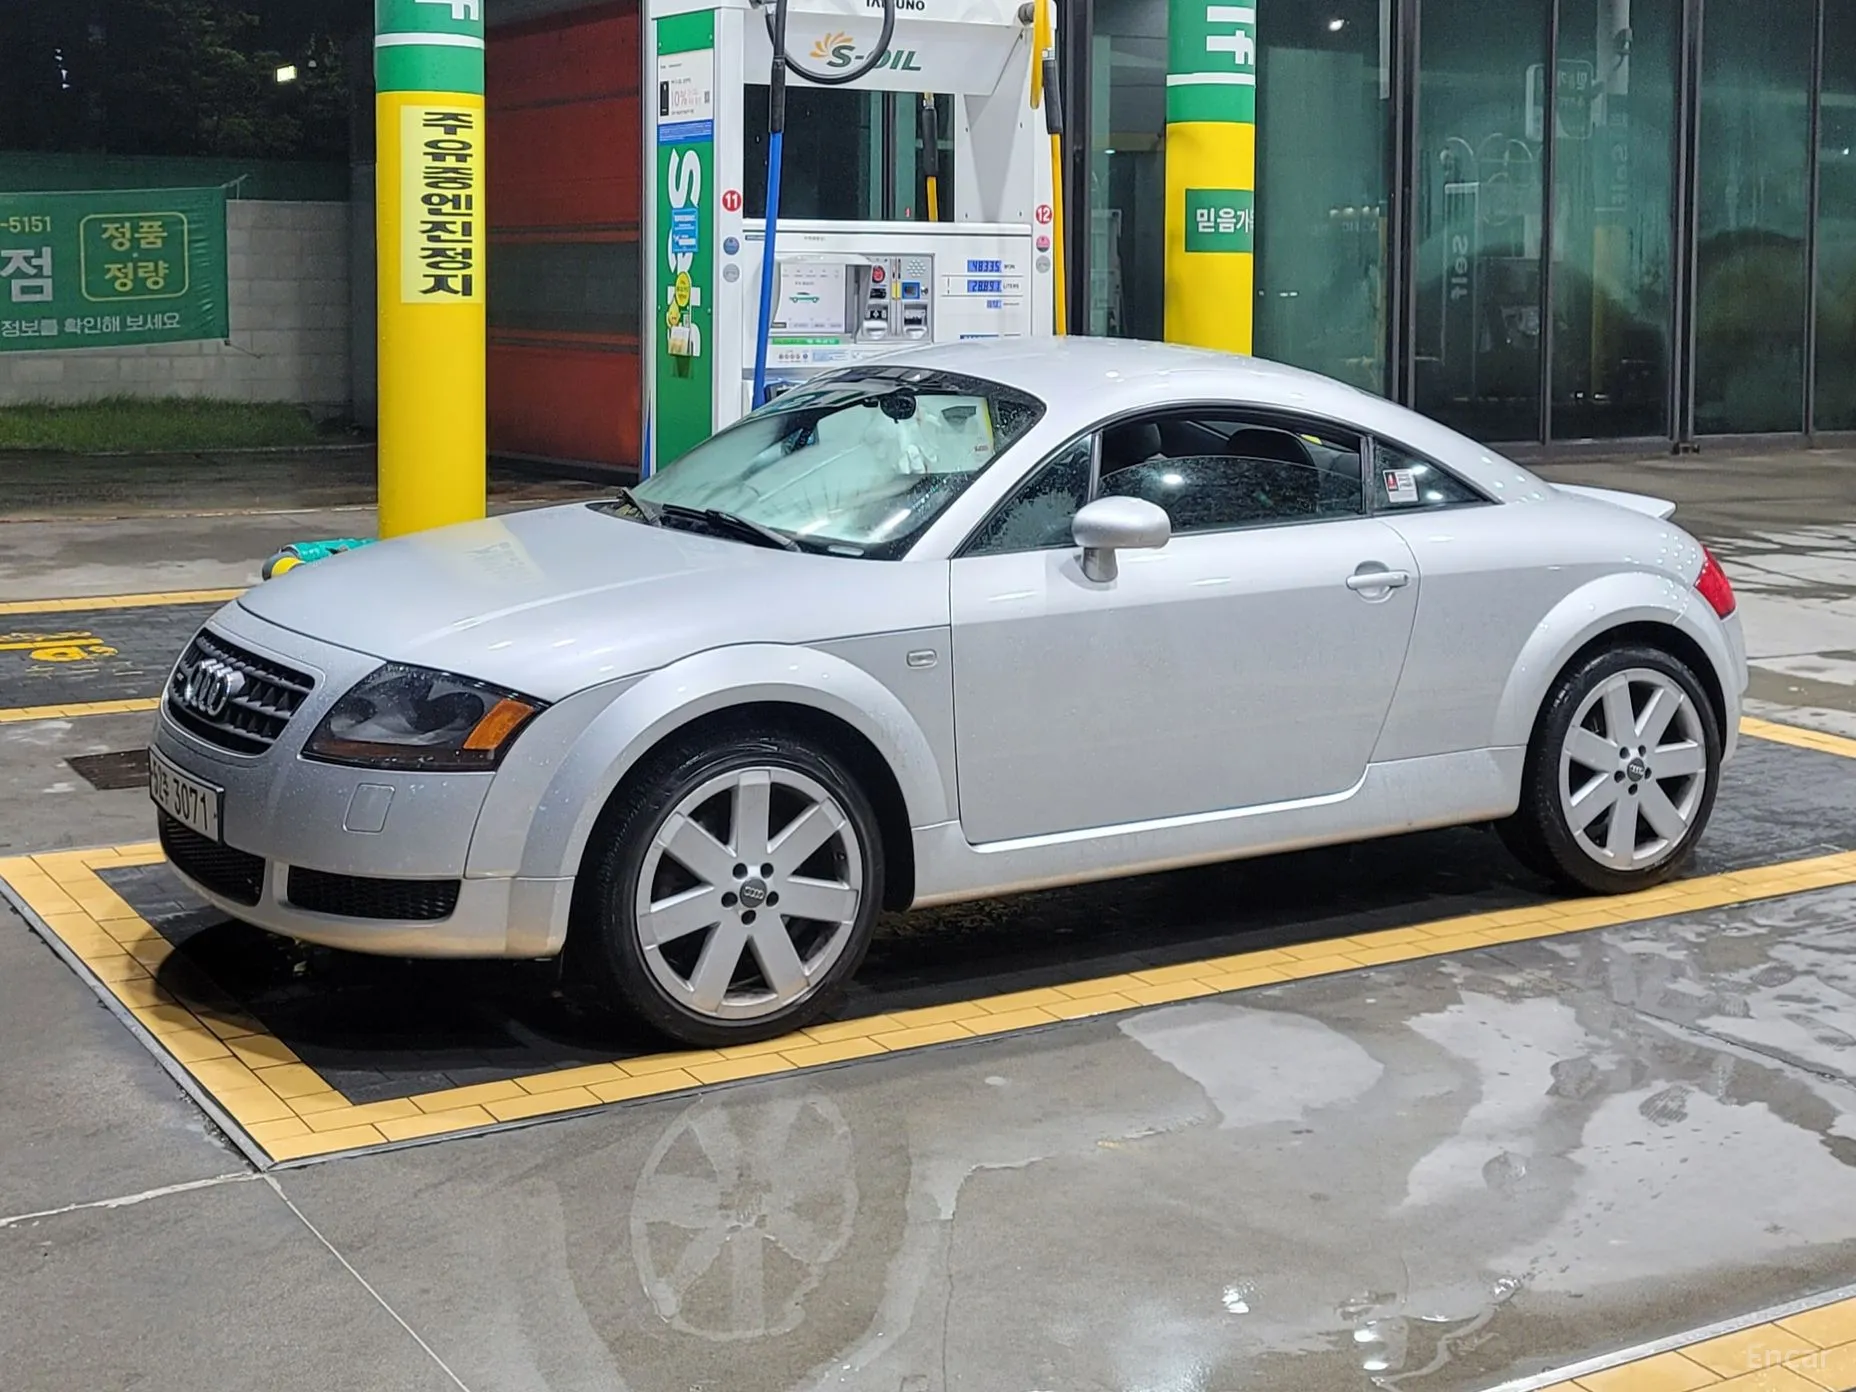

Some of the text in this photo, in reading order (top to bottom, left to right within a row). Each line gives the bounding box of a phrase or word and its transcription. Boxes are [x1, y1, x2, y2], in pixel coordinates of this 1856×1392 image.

[826, 44, 922, 71] S-OIL
[724, 193, 739, 208] 11
[1037, 207, 1050, 223] 12
[1196, 207, 1253, 233] 믿음가
[101, 220, 168, 251] 정품
[0, 247, 54, 303] 점
[104, 259, 170, 291] 정량
[2, 312, 181, 338] 정보를 확인해 보세요
[173, 777, 208, 831] 3071
